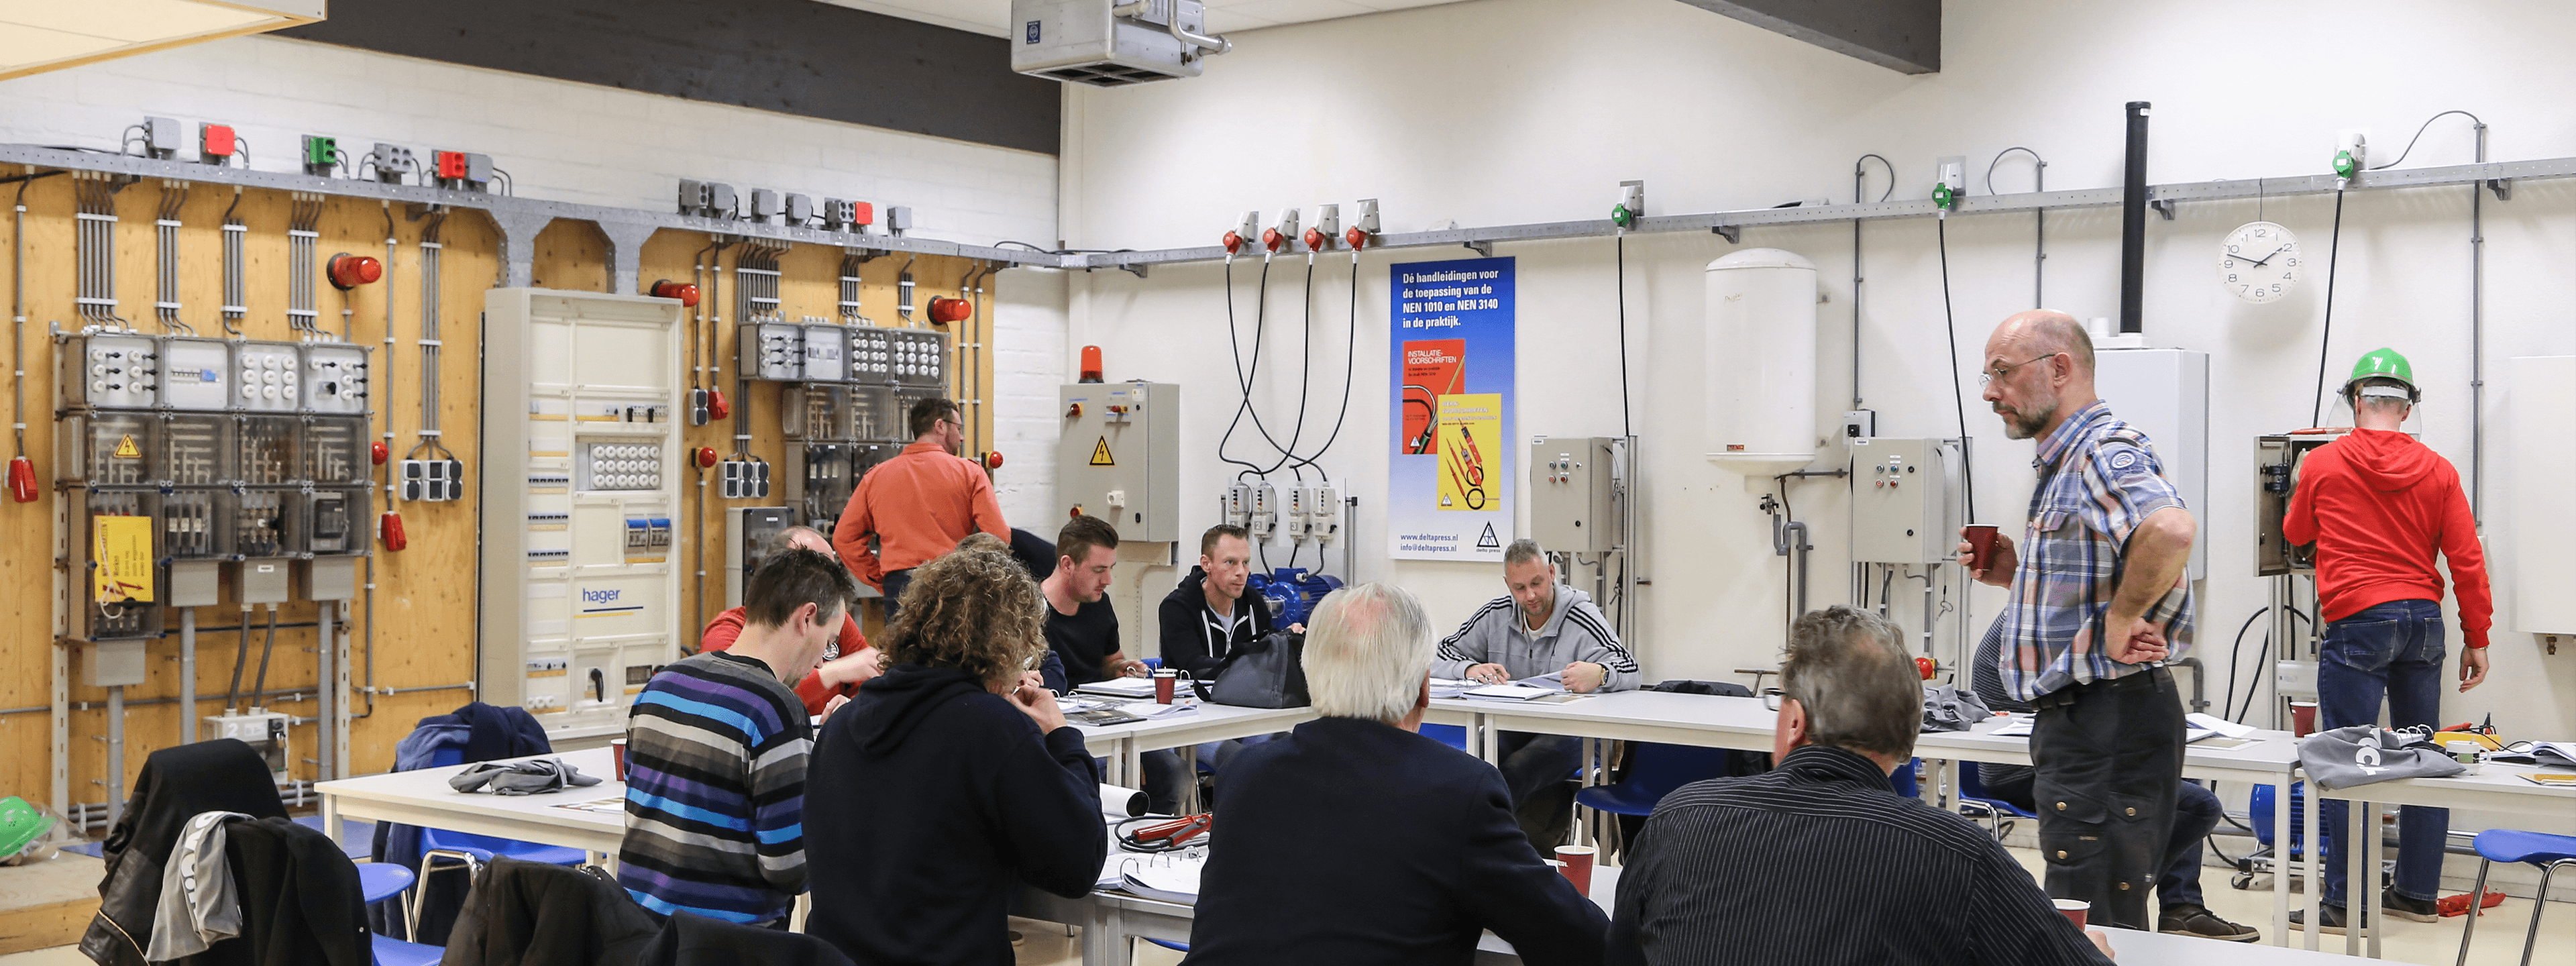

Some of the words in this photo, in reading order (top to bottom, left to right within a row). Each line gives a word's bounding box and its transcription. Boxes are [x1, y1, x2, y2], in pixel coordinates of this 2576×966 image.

[2254, 229, 2266, 237] 12
[2227, 245, 2239, 254] 10
[2284, 243, 2292, 252] 2
[2224, 260, 2233, 268] 9
[2288, 258, 2296, 266] 3
[1403, 273, 1414, 284] Dé
[1417, 270, 1477, 283] handleidingen
[1480, 270, 1499, 279] voor
[2229, 274, 2237, 282] 8
[2283, 272, 2292, 280] 4
[1403, 288, 1413, 299] de
[1415, 286, 1461, 300] toepassing
[1464, 286, 1479, 295] van
[1481, 284, 1492, 294] de
[2241, 284, 2249, 293] 7
[2255, 288, 2265, 297] 6
[2272, 284, 2281, 292] 5
[1403, 303, 1421, 313] NEN
[1424, 302, 1443, 313] 1010
[1444, 303, 1455, 311] en
[1457, 300, 1477, 311] NEN
[1479, 299, 1498, 310] 3140
[1403, 318, 1411, 328] in
[1413, 317, 1424, 327] de
[1426, 315, 1461, 330] praktijk.
[1408, 356, 1456, 364] VOORSCHRIFTEN
[1401, 533, 1458, 542] www.deltapress.nl
[1401, 544, 1457, 553] info@deltapress.nl
[583, 588, 621, 604] hager
[228, 723, 238, 738] 2
